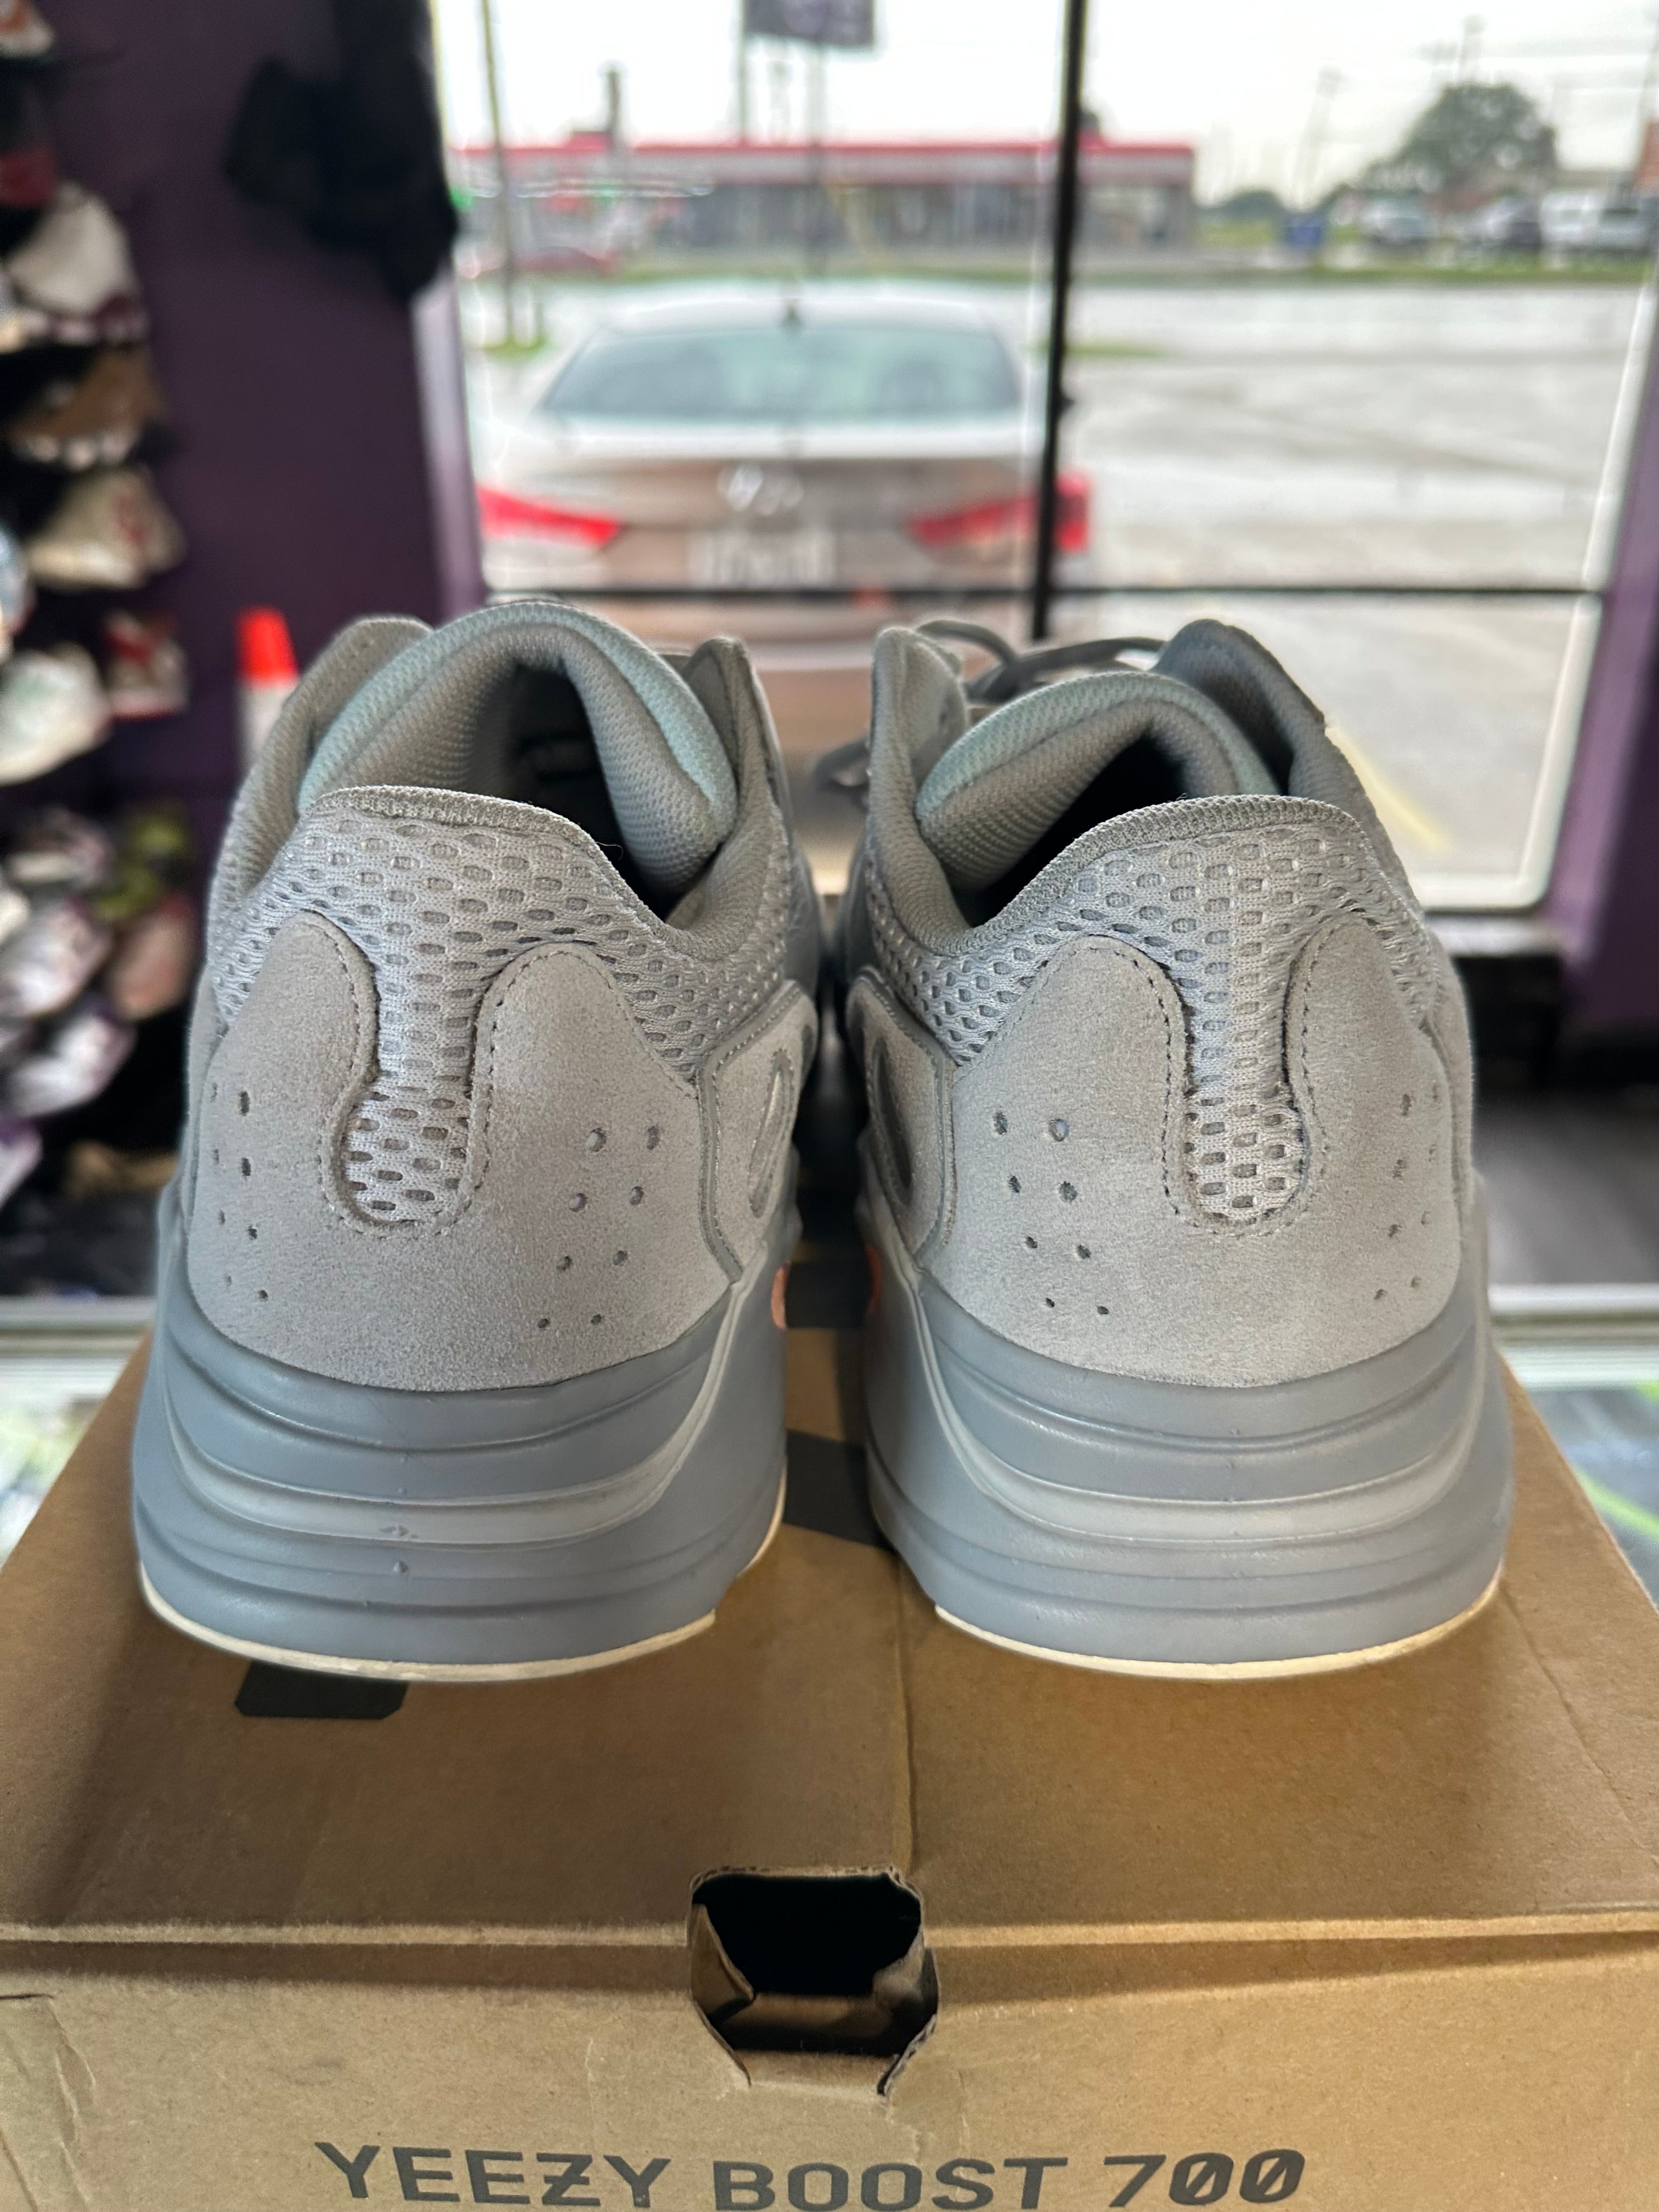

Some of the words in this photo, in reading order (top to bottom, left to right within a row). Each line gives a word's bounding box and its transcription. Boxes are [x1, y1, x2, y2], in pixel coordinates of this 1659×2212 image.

[314, 2142, 672, 2208] YEEZY
[713, 2157, 1068, 2211] BOOST
[1104, 2149, 1305, 2207] 700
